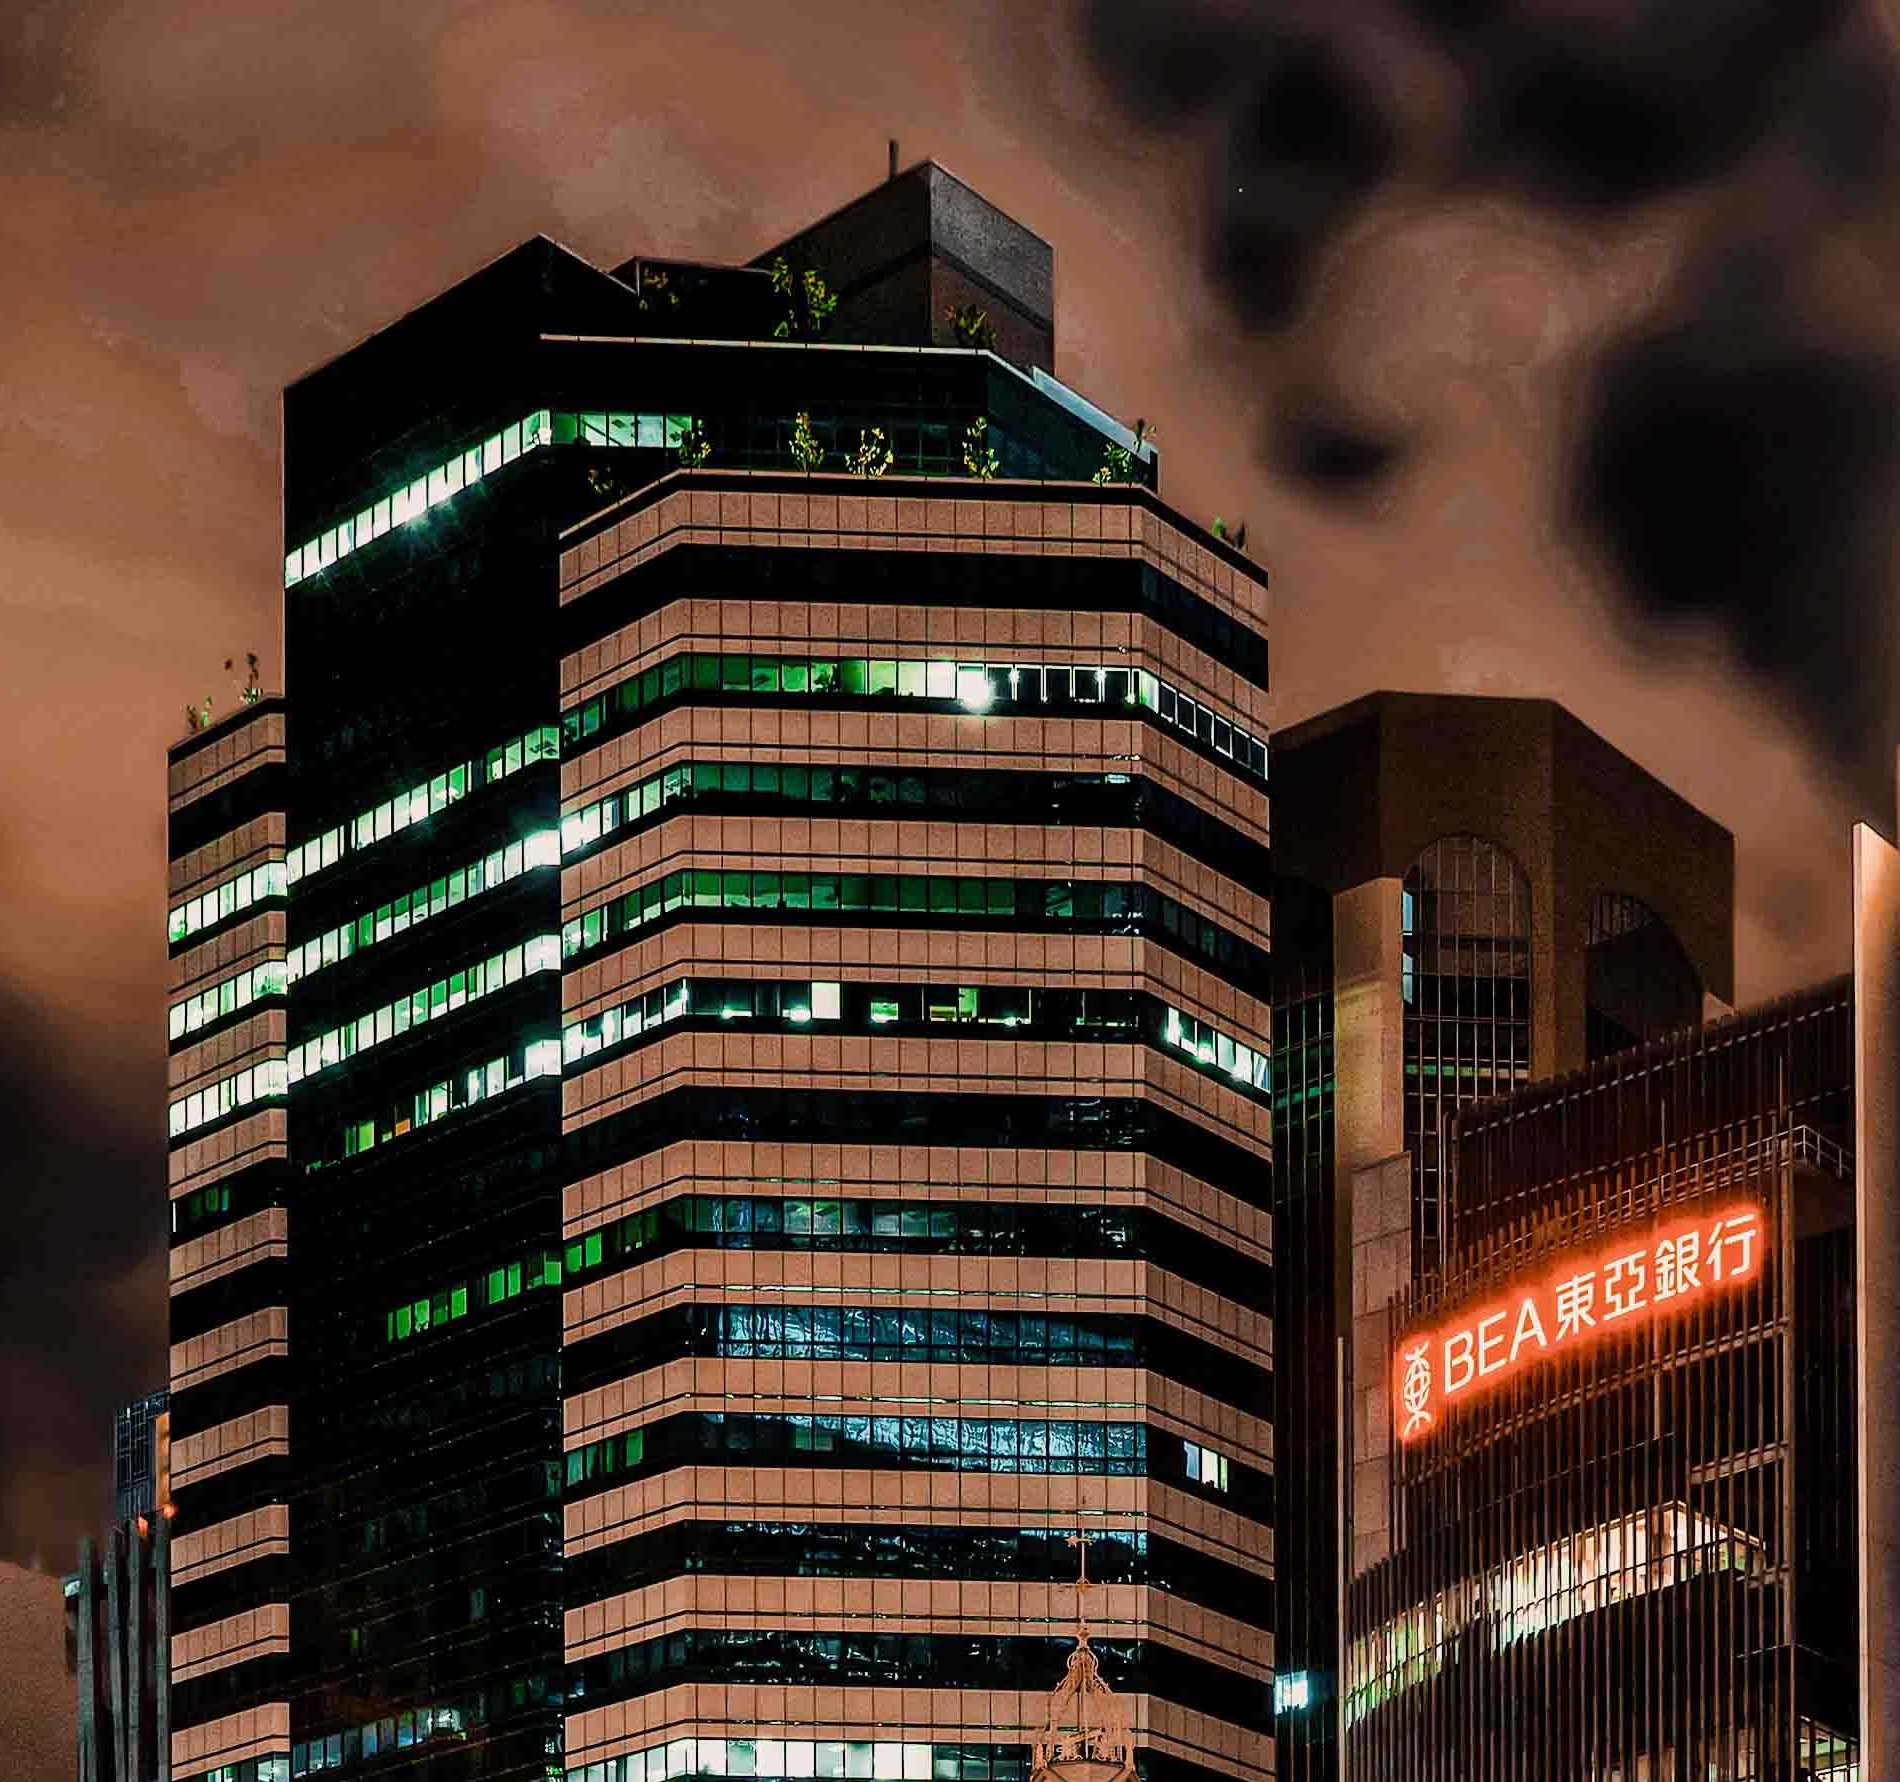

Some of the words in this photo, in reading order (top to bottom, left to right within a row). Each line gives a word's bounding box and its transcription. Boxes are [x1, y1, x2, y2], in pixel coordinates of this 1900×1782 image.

[1443, 1297, 1548, 1394] BEA
[1554, 1213, 1758, 1342] 東亞銀行
